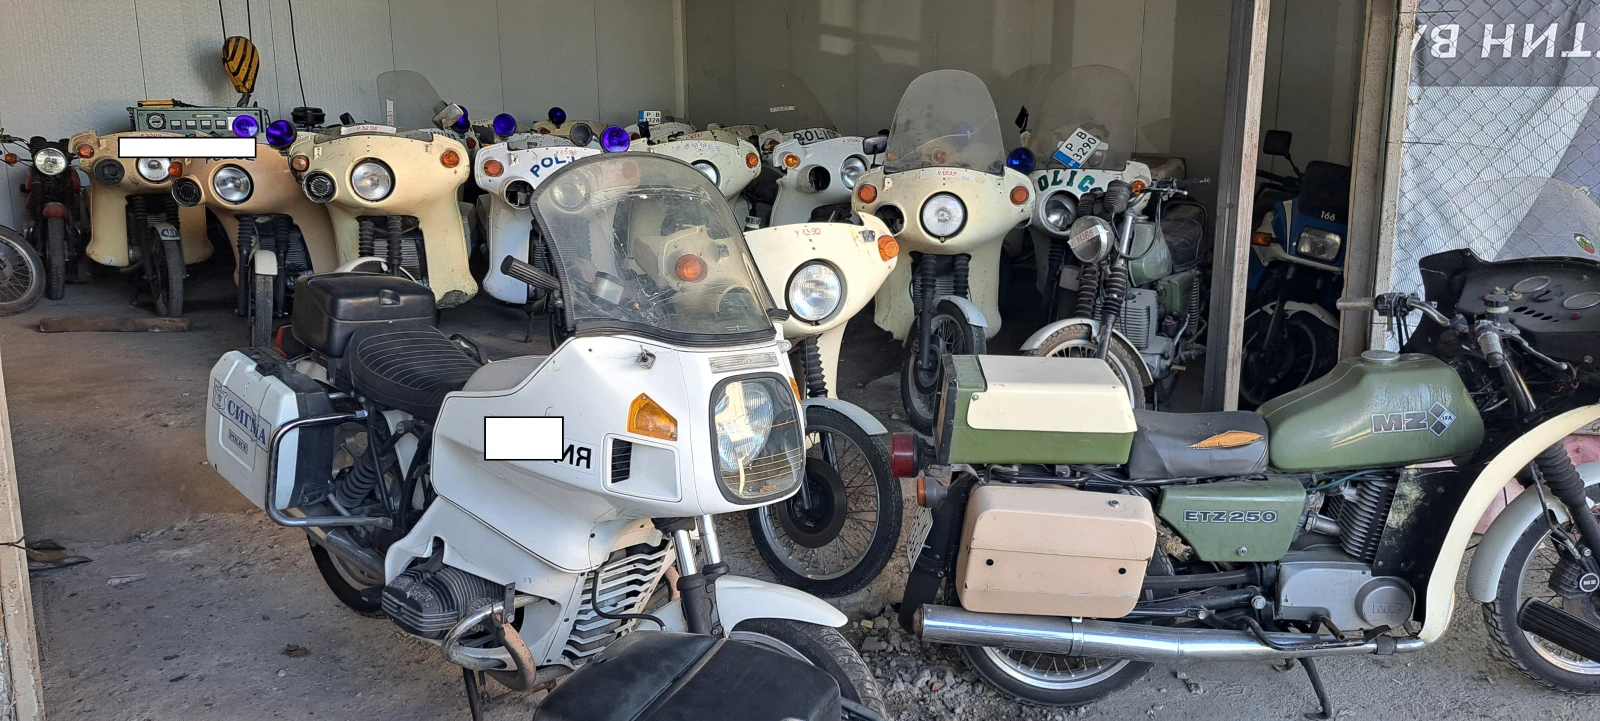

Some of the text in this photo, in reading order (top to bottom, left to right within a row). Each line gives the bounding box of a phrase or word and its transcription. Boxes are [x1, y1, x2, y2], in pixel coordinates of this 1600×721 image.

[1481, 22, 1600, 59] ТИН
[1072, 137, 1097, 161] 3290
[1037, 170, 1096, 192] OLIC
[1320, 210, 1336, 221] 166
[228, 400, 267, 446] СИГМА
[1371, 410, 1429, 433] MZ
[1184, 509, 1277, 523] ETZ 250
[1372, 603, 1404, 614] MZ
